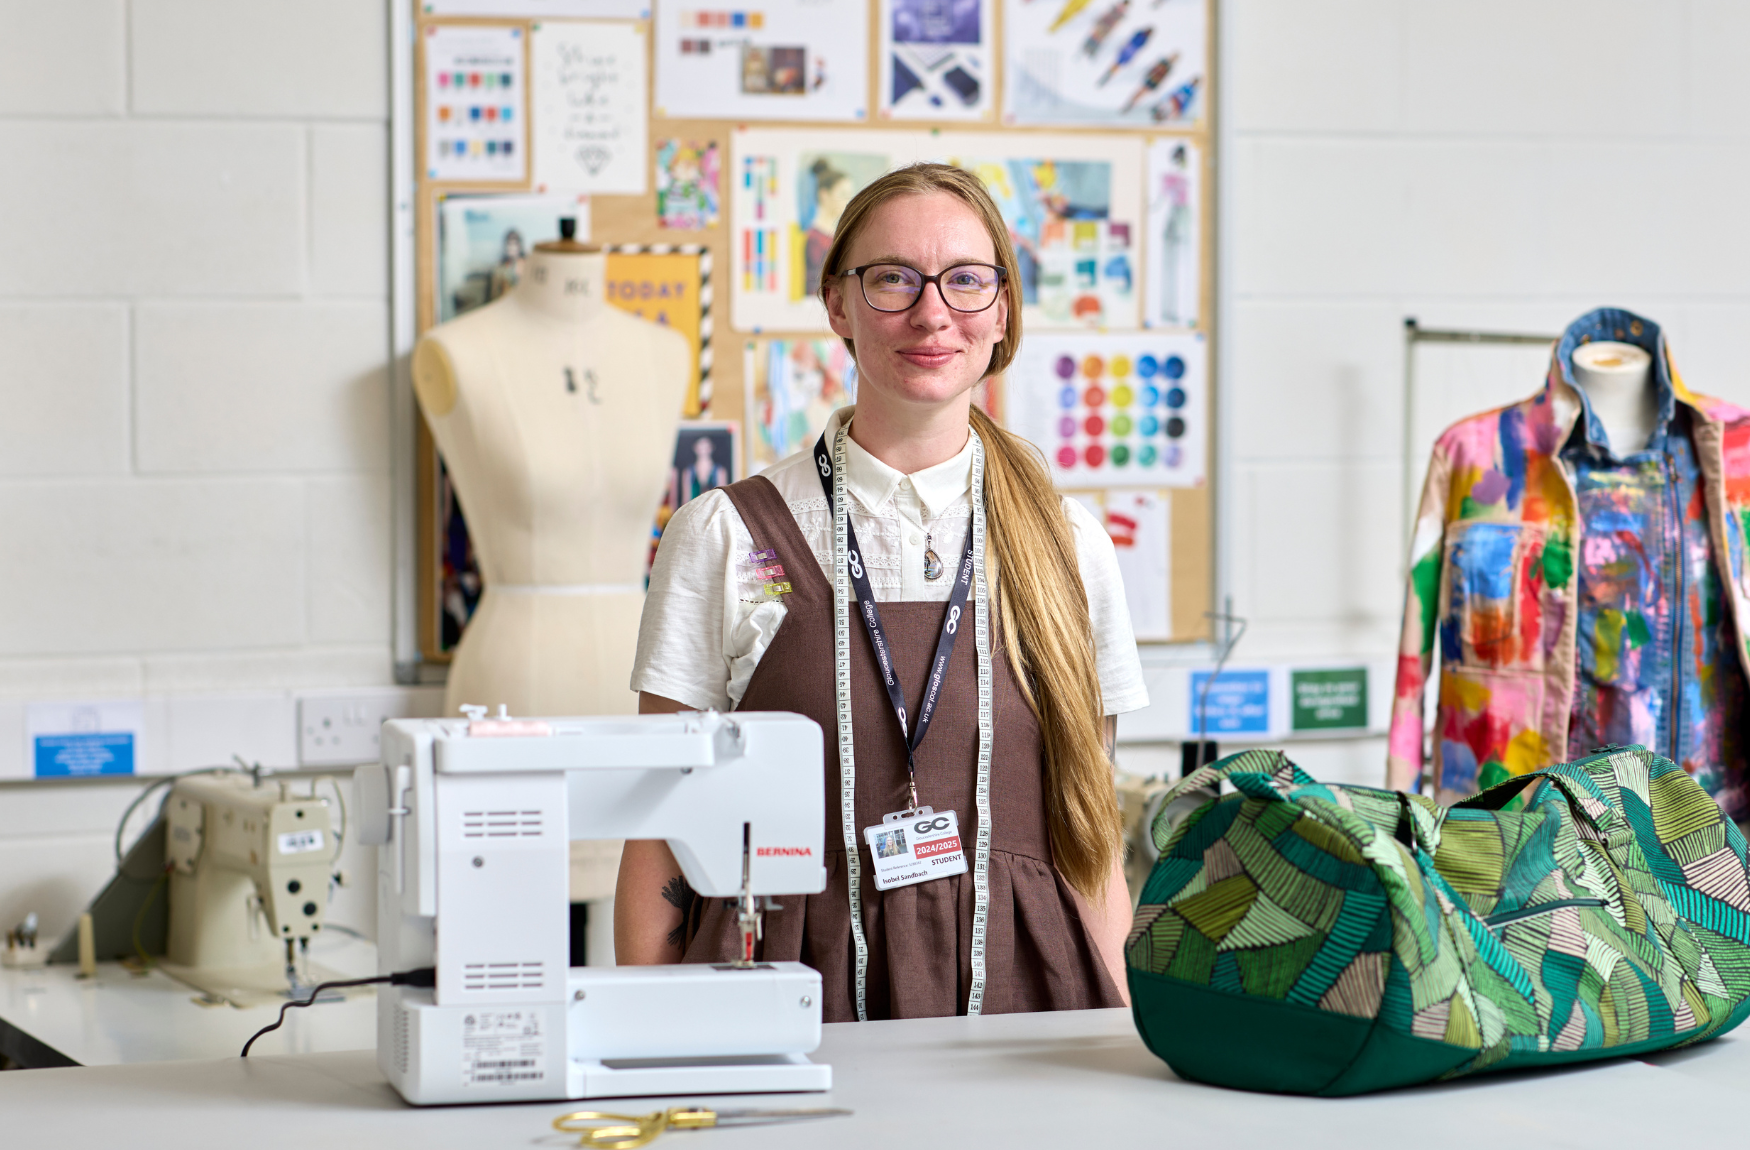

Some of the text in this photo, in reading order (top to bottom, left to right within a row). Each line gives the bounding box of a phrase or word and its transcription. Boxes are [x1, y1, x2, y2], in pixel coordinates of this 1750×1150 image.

[607, 280, 688, 299] TODAY
[960, 550, 973, 586] STUDENT
[946, 605, 960, 635] GC
[864, 600, 894, 686] Gloucestershire College
[922, 655, 946, 724] www.gloscol.ac.uk
[914, 816, 950, 834] GC
[756, 846, 812, 856] BERNINA
[916, 840, 958, 855] 2024/2025
[931, 854, 962, 866] STUDENT
